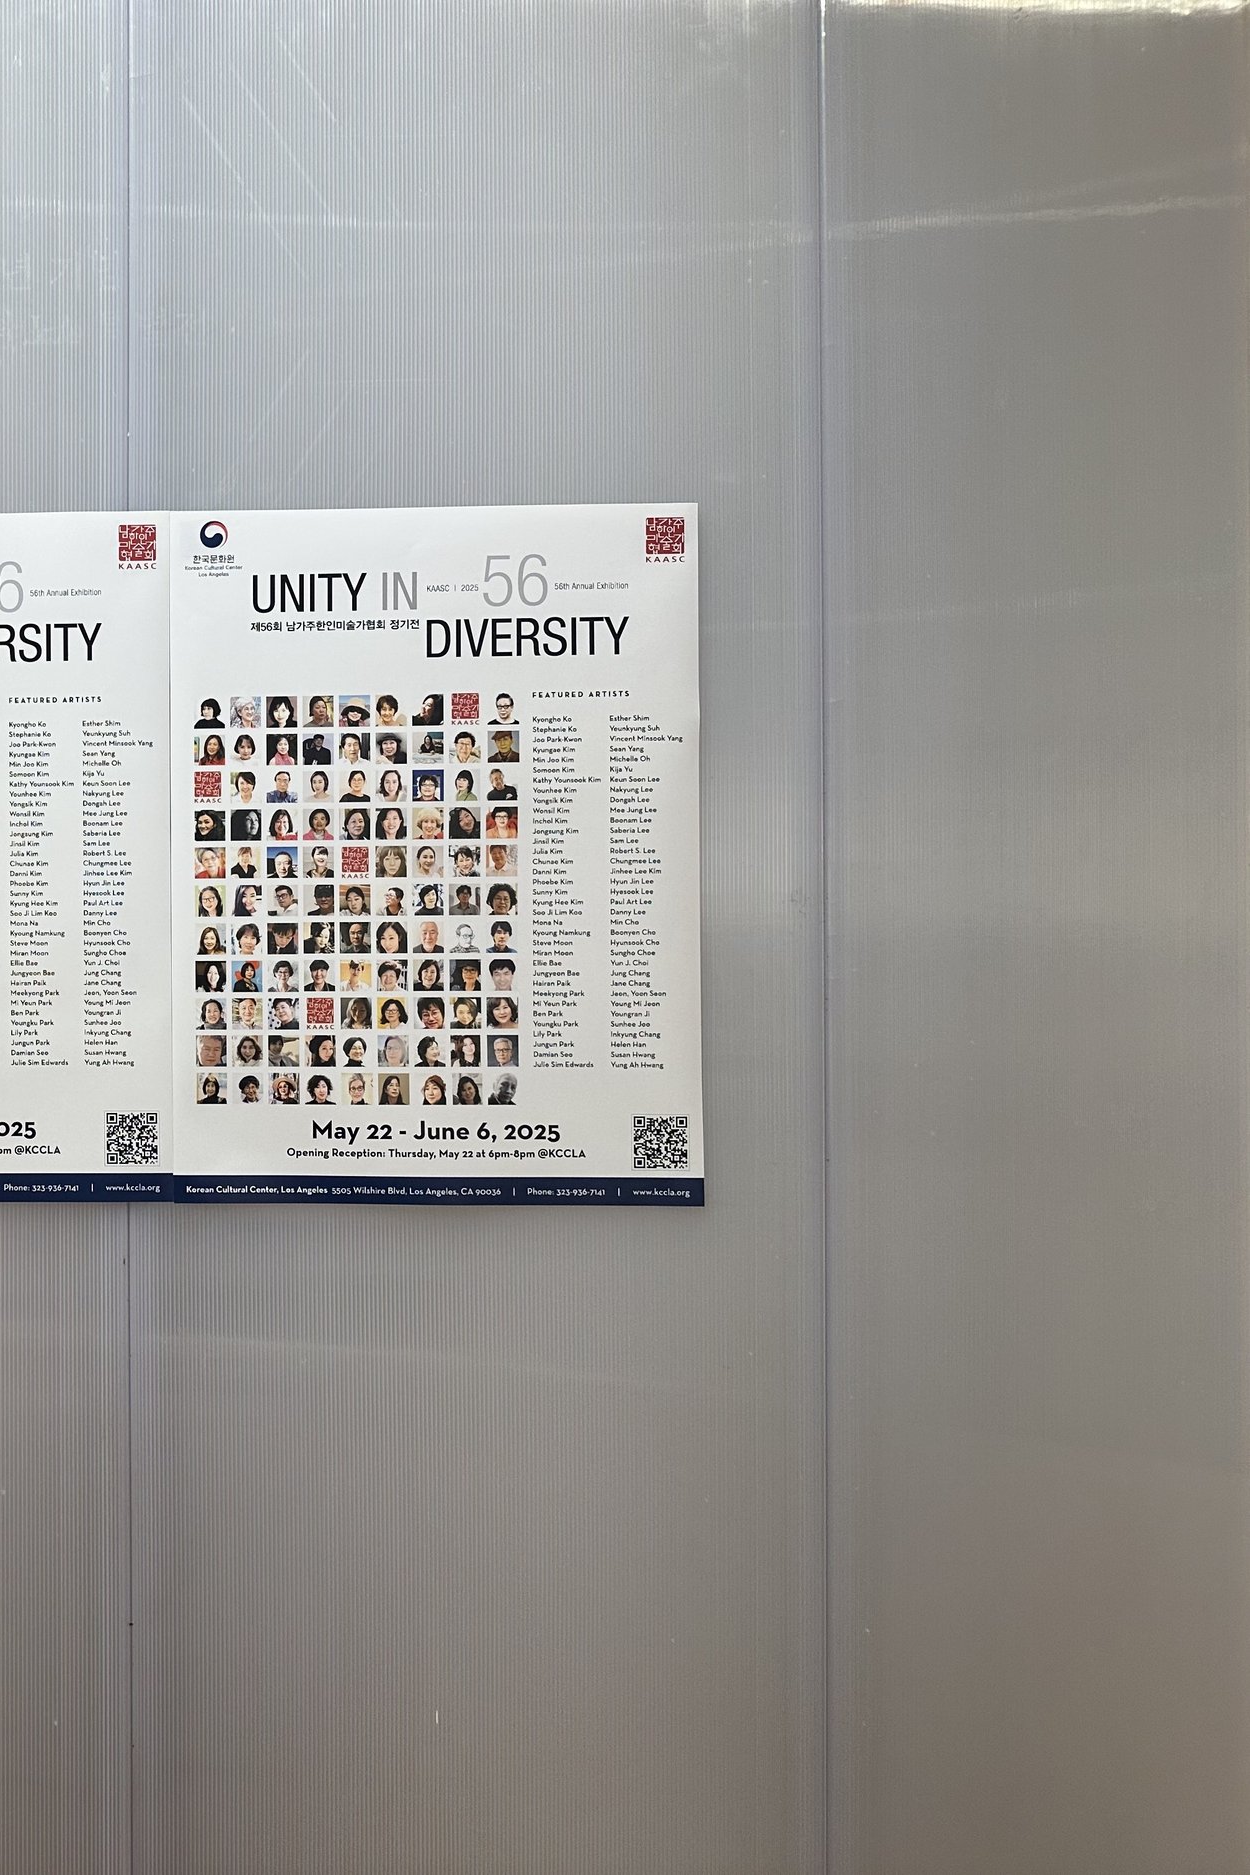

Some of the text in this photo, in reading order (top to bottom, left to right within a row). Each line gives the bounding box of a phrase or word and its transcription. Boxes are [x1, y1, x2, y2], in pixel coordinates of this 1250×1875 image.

[193, 554, 235, 565] 한국문화원
[645, 555, 686, 564] KAASC
[118, 562, 157, 570] KAASC
[482, 553, 549, 608] 56
[426, 583, 479, 593] KAASC 2025
[554, 581, 629, 591] 56th Annual Exhibition
[29, 588, 102, 598] 56th Annual Exhibition
[252, 571, 418, 614] UNITY IN
[250, 619, 420, 633] 제56회 남가주한인미술가협회 정기전
[426, 616, 630, 659] DIVERSITY
[532, 690, 630, 699] FEATURED ARTISTS
[8, 696, 102, 704] FEATURED ARTISTS
[9, 890, 30, 899] Sunny
[532, 898, 554, 908] Kyung
[570, 898, 584, 906] Kim
[610, 908, 647, 917] Danny Lee
[312, 1120, 361, 1146] May
[366, 1124, 393, 1140] 22
[413, 1120, 470, 1141] June
[476, 1122, 498, 1144] 6,
[504, 1124, 561, 1143] 2025
[14, 1145, 62, 1156] @KCCLA
[286, 1147, 587, 1161] Opening Reception: Thursday, May 22 at 6pm-8pm @KCCLA
[3, 1183, 31, 1192] Phone:
[32, 1184, 79, 1193] 323-936-7141
[105, 1183, 161, 1193] www.kccla.org
[186, 1185, 691, 1199] Korean Cultural Center, Los Angeles 5505 Wilshire Blvd, Los Angeles, CA 90036 Phone: 323-936-7141 www.kccla.org
